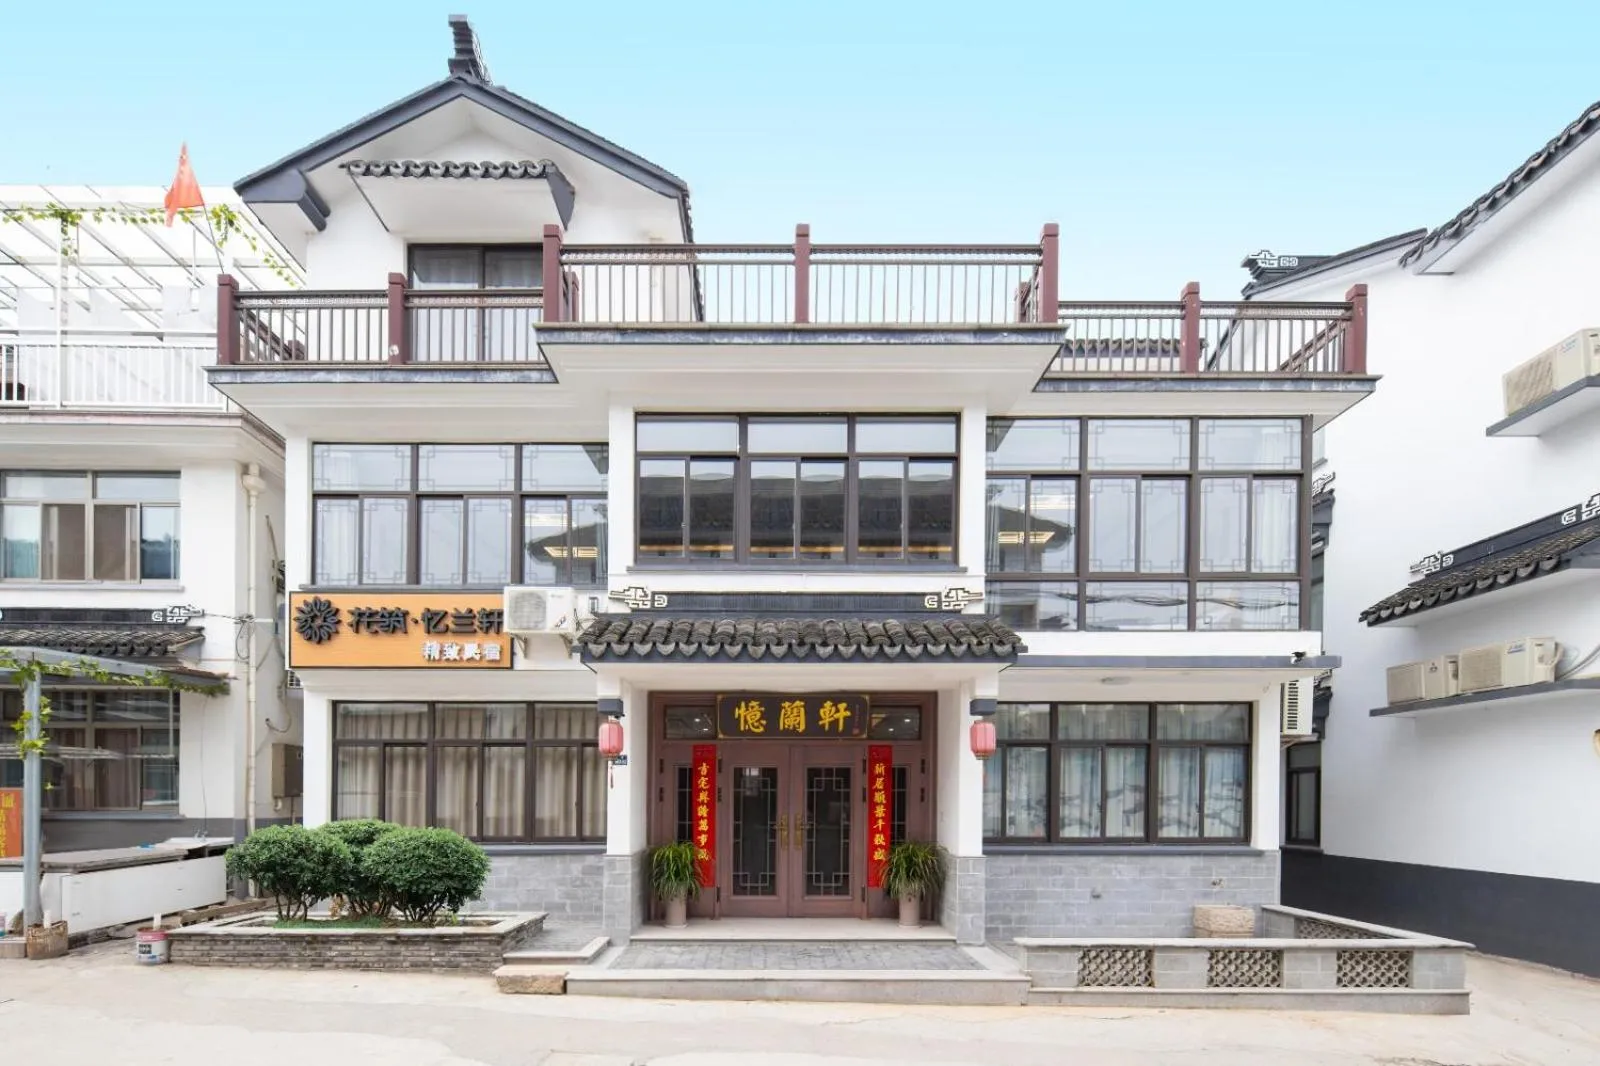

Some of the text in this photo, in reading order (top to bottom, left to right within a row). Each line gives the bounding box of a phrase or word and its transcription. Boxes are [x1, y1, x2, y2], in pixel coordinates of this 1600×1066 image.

[347, 606, 504, 635] 花筑·忆兰轩
[734, 700, 851, 733] 憶蘭軒
